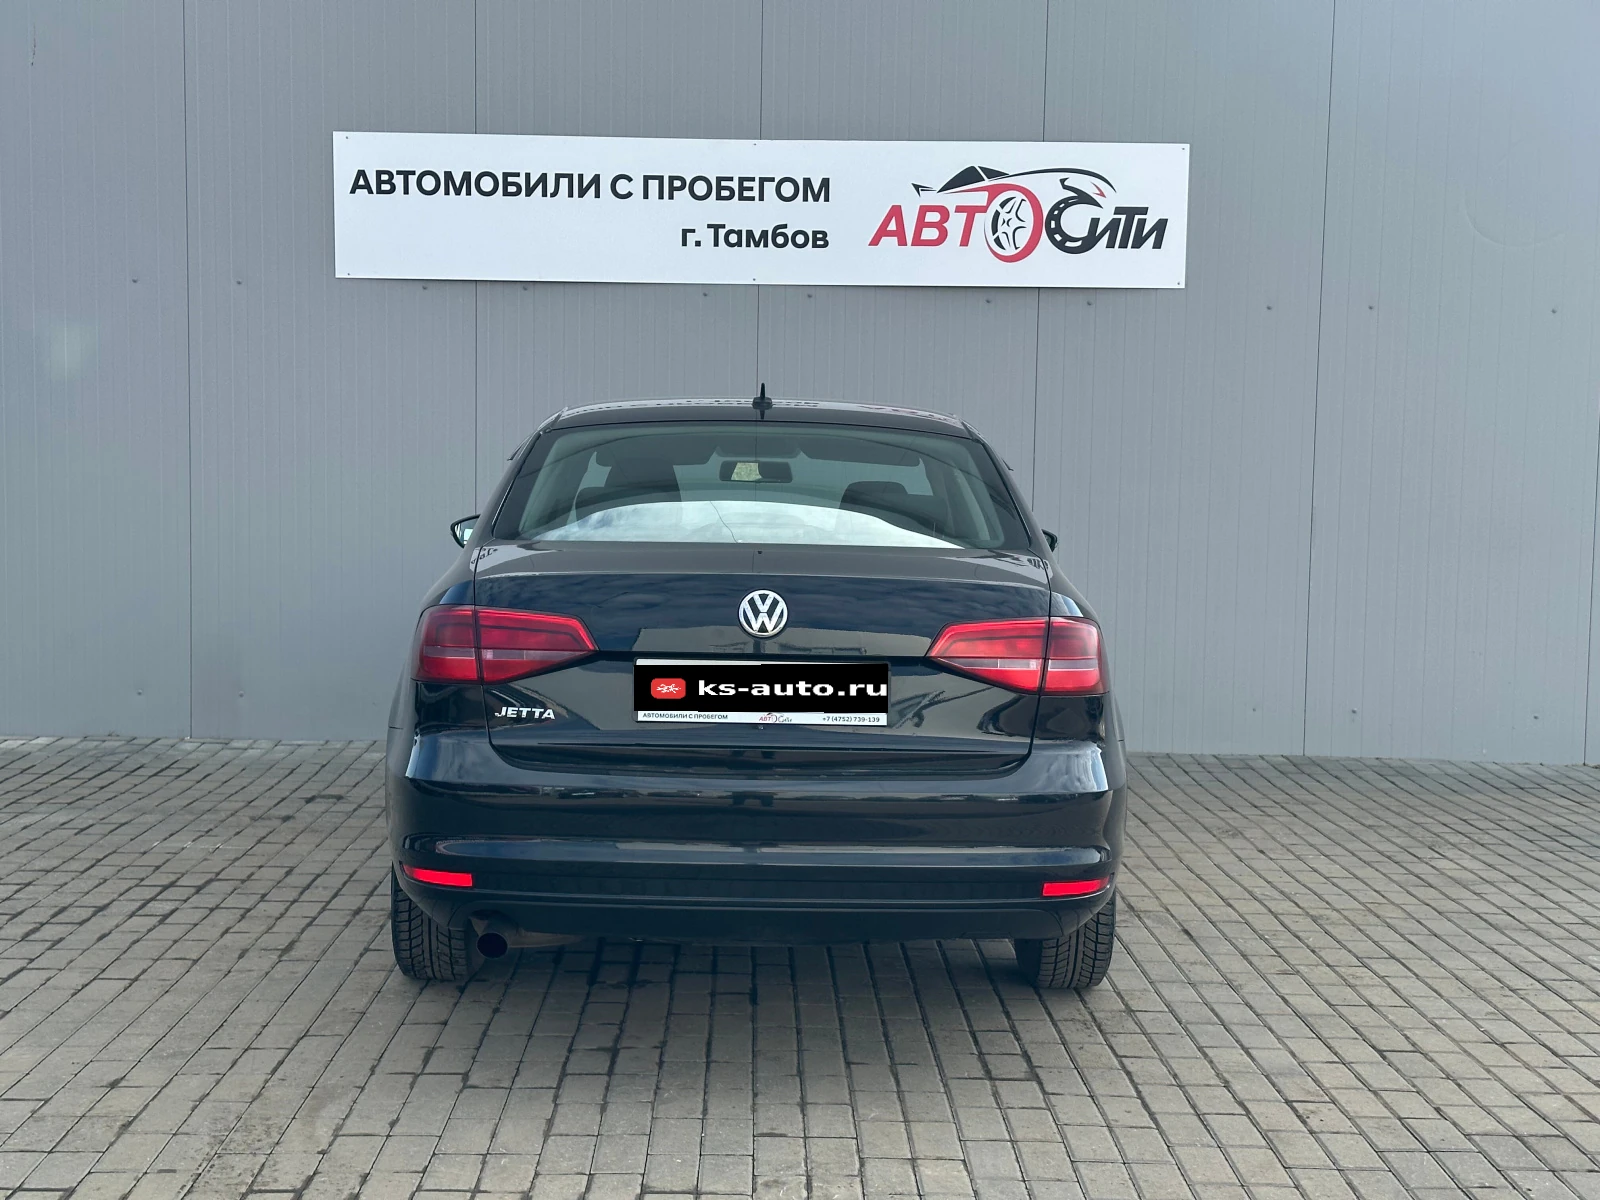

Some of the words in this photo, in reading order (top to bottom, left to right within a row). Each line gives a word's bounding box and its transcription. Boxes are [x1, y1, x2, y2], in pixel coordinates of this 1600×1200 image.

[350, 169, 601, 199] АВТОМОБИЛИ
[610, 173, 634, 200] С
[642, 175, 831, 203] ПРОБЕГОМ
[681, 228, 702, 248] г.
[706, 223, 830, 249] Тамбов
[494, 706, 556, 720] JETTA
